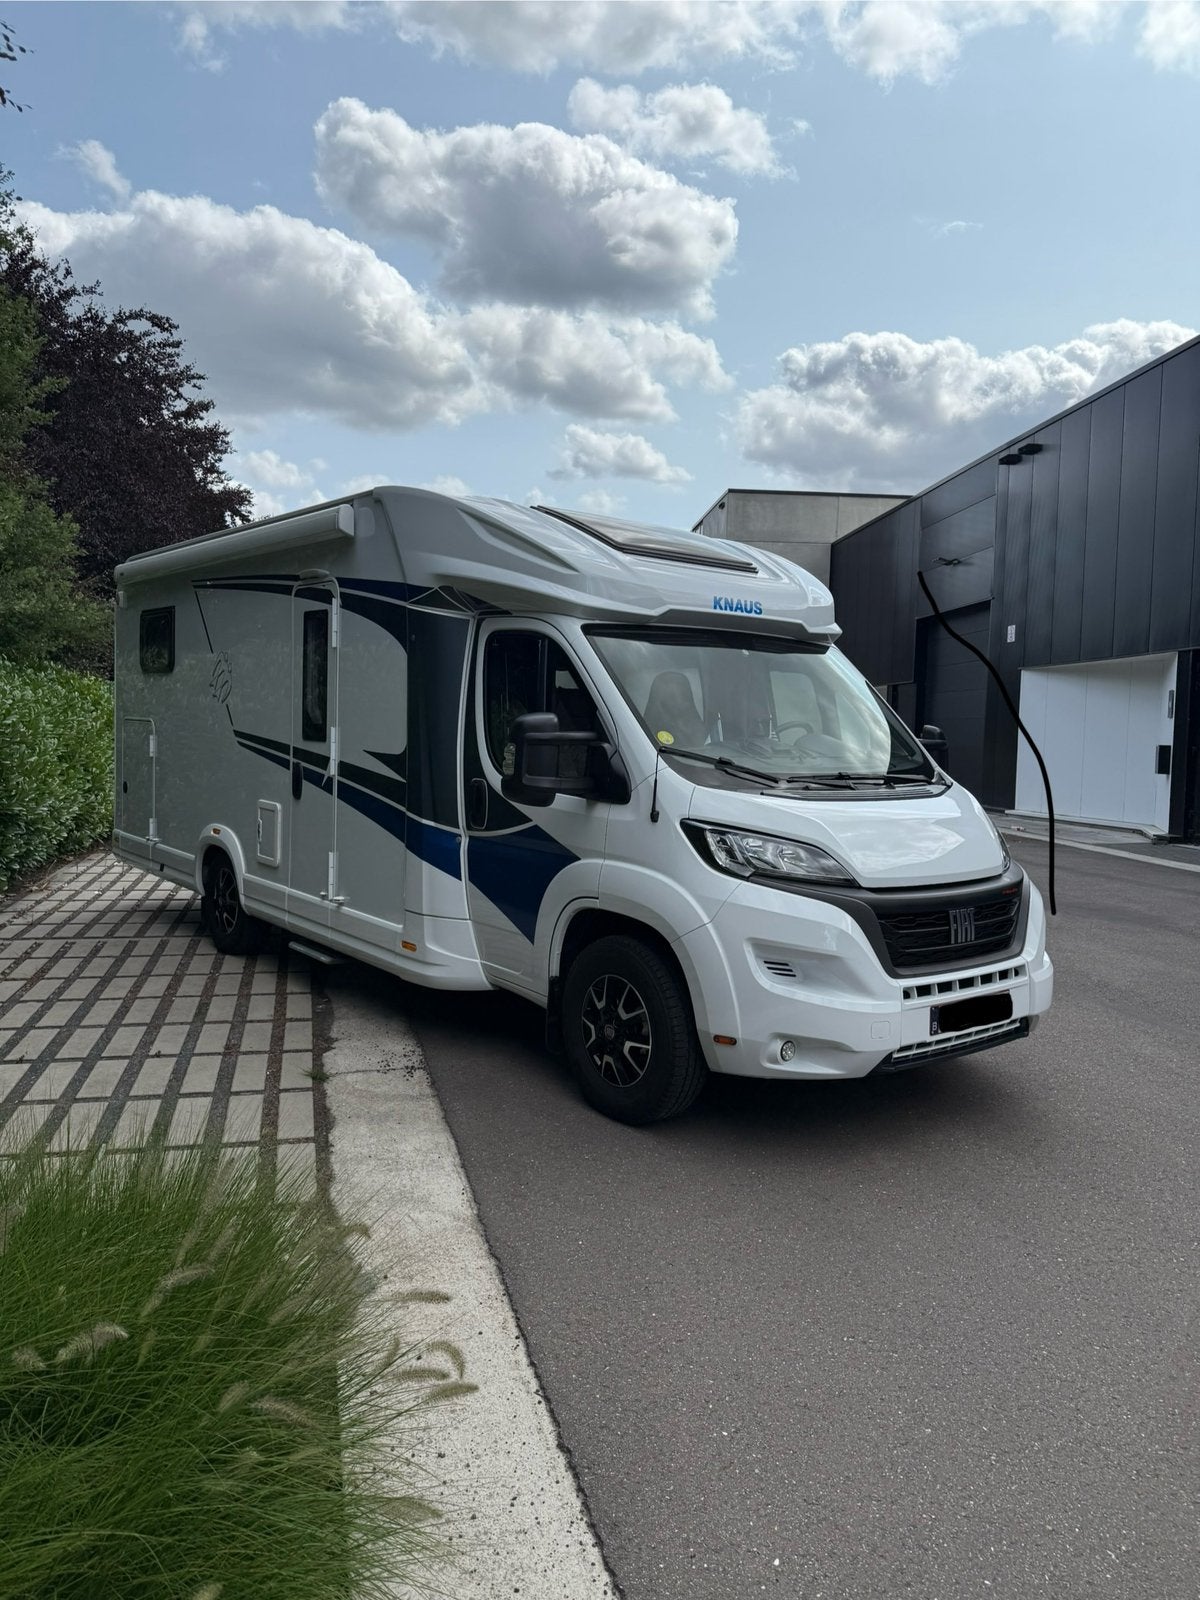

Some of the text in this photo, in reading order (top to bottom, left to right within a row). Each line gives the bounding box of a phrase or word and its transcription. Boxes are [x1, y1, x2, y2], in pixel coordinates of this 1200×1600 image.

[713, 595, 763, 615] KNAUS
[949, 907, 975, 944] FIAT
[932, 1021, 938, 1031] B
